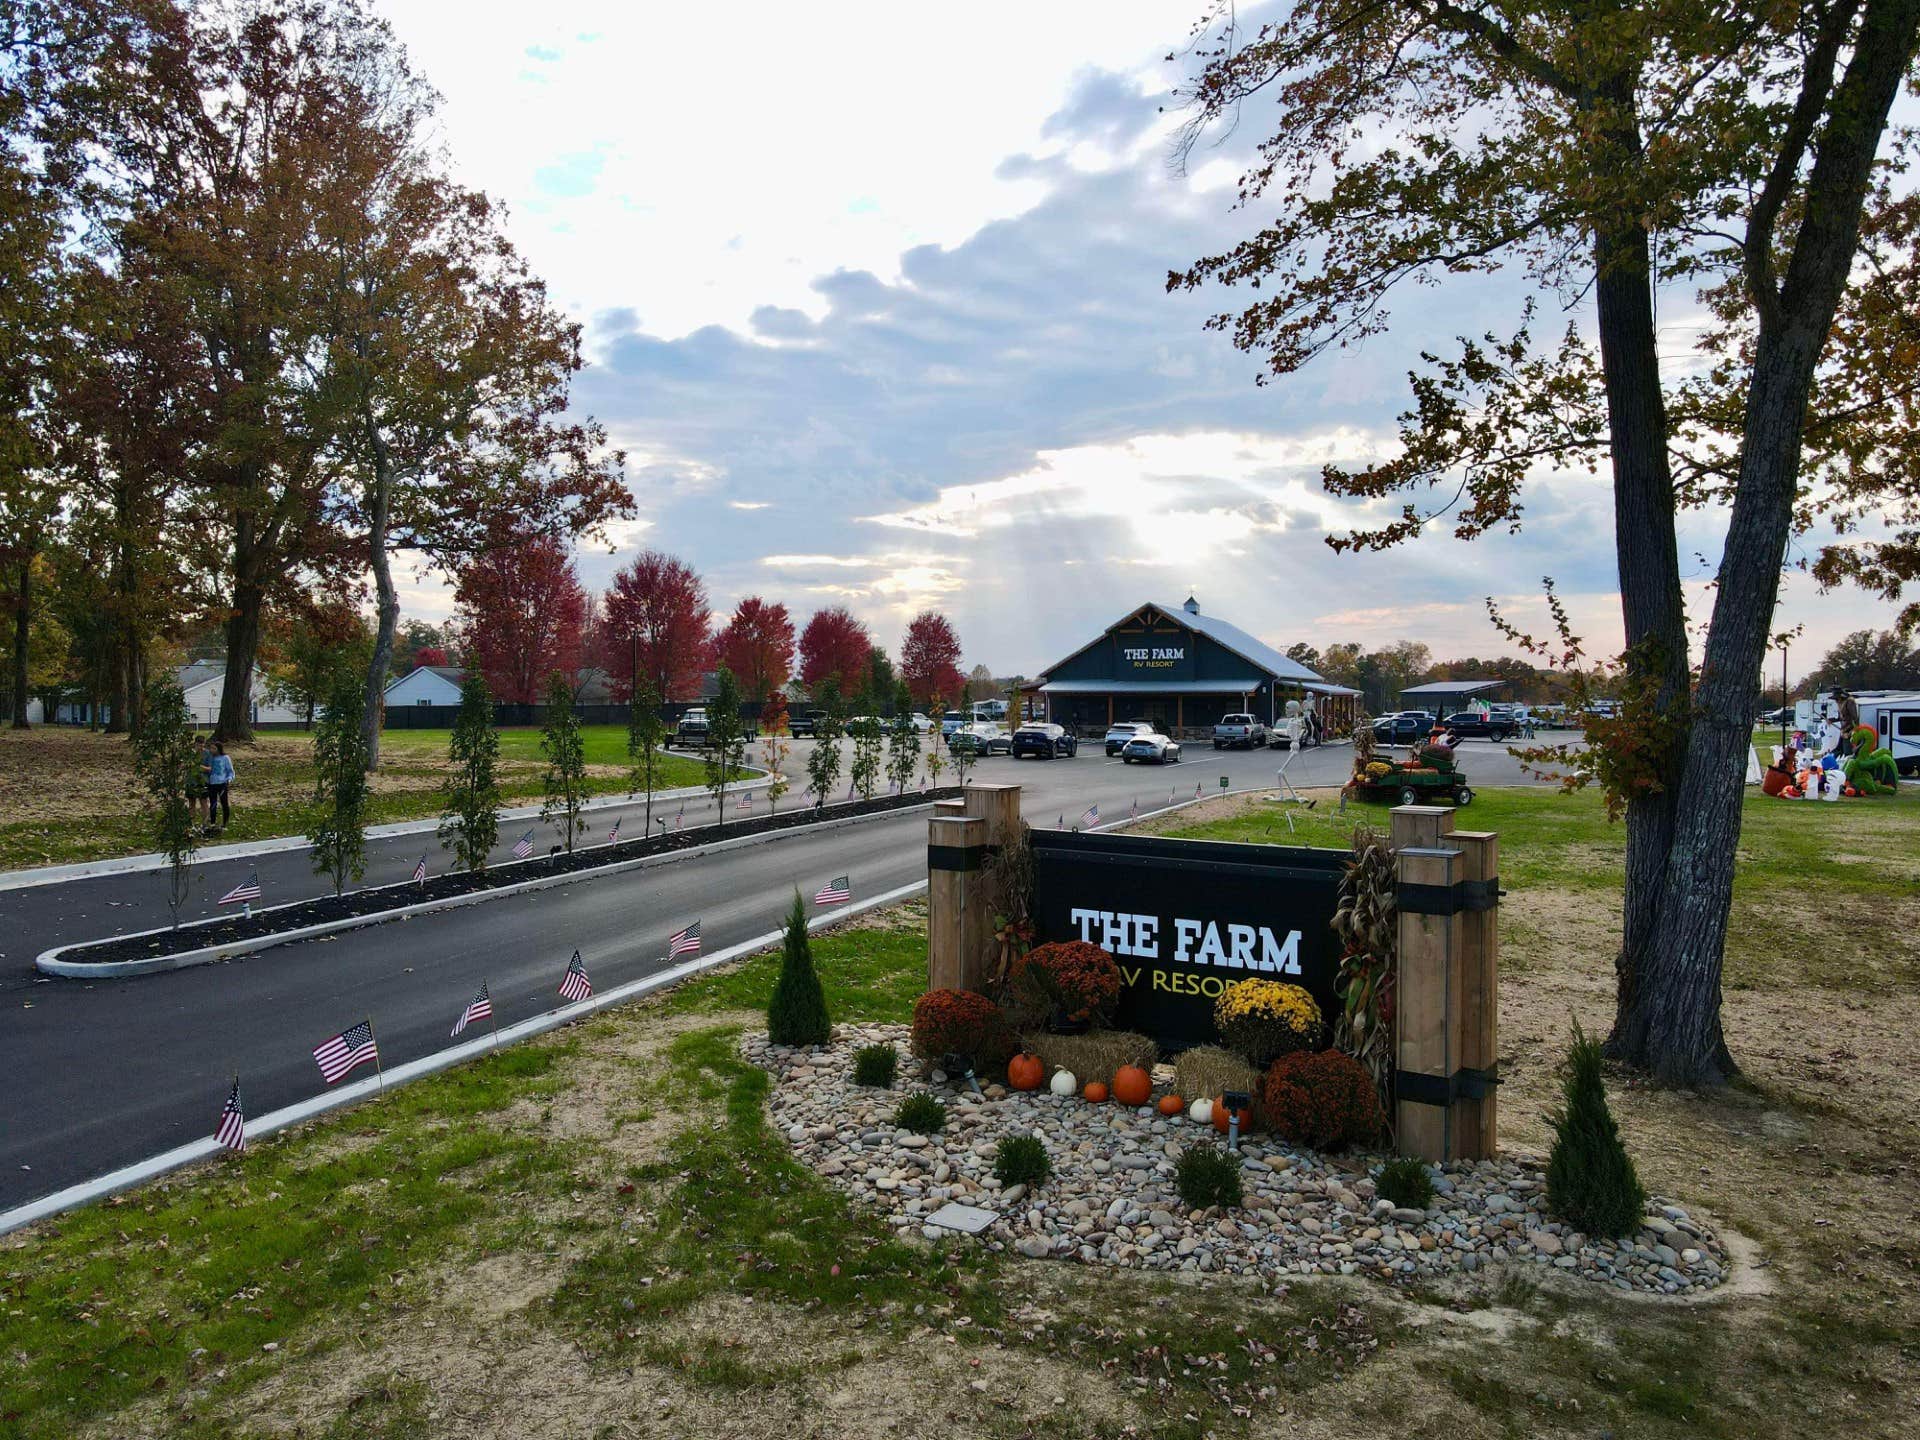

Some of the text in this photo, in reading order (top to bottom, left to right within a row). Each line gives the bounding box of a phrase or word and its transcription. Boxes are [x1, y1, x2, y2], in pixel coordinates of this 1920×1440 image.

[1124, 647, 1185, 660] THE FARM
[1133, 660, 1175, 668] RV RESORT
[1071, 907, 1302, 975] THE FARM
[1120, 965, 1142, 987] V
